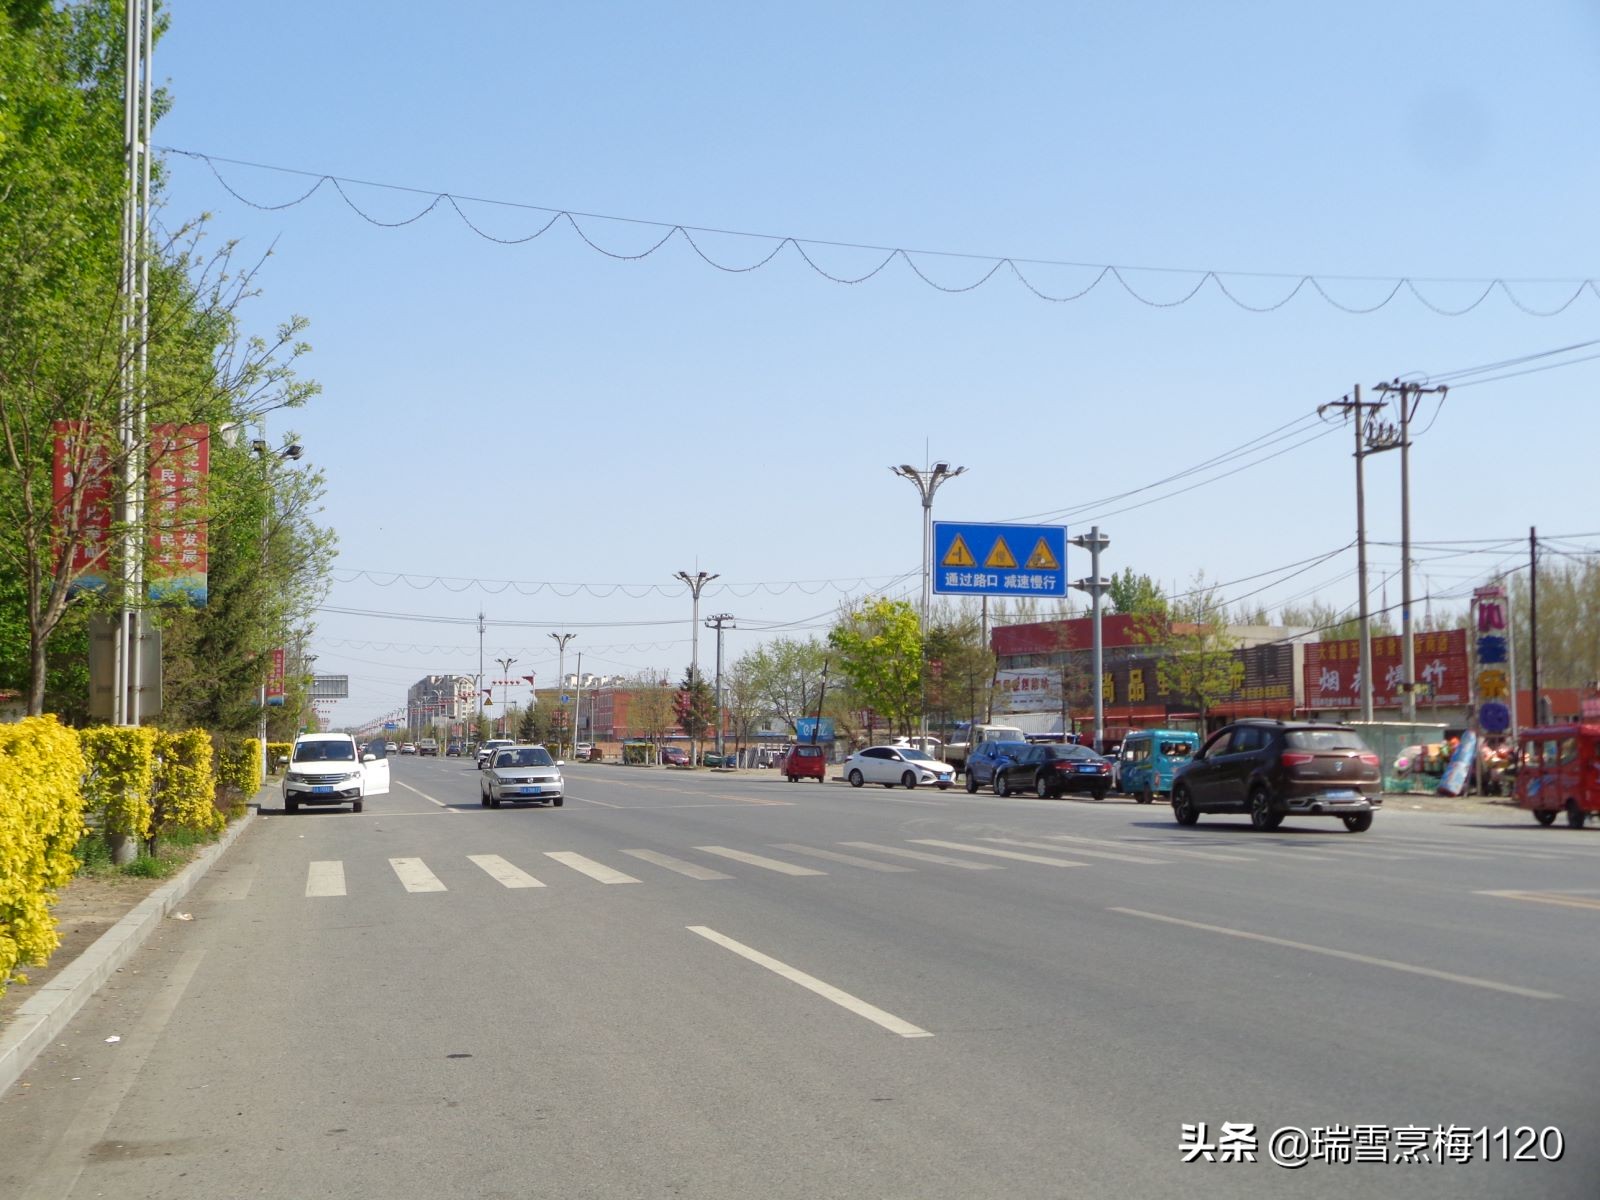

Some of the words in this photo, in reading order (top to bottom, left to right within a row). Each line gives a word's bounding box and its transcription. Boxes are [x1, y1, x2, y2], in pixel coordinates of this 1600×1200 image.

[945, 572, 998, 587] 通过路口
[1004, 574, 1056, 590] 减速慢行
